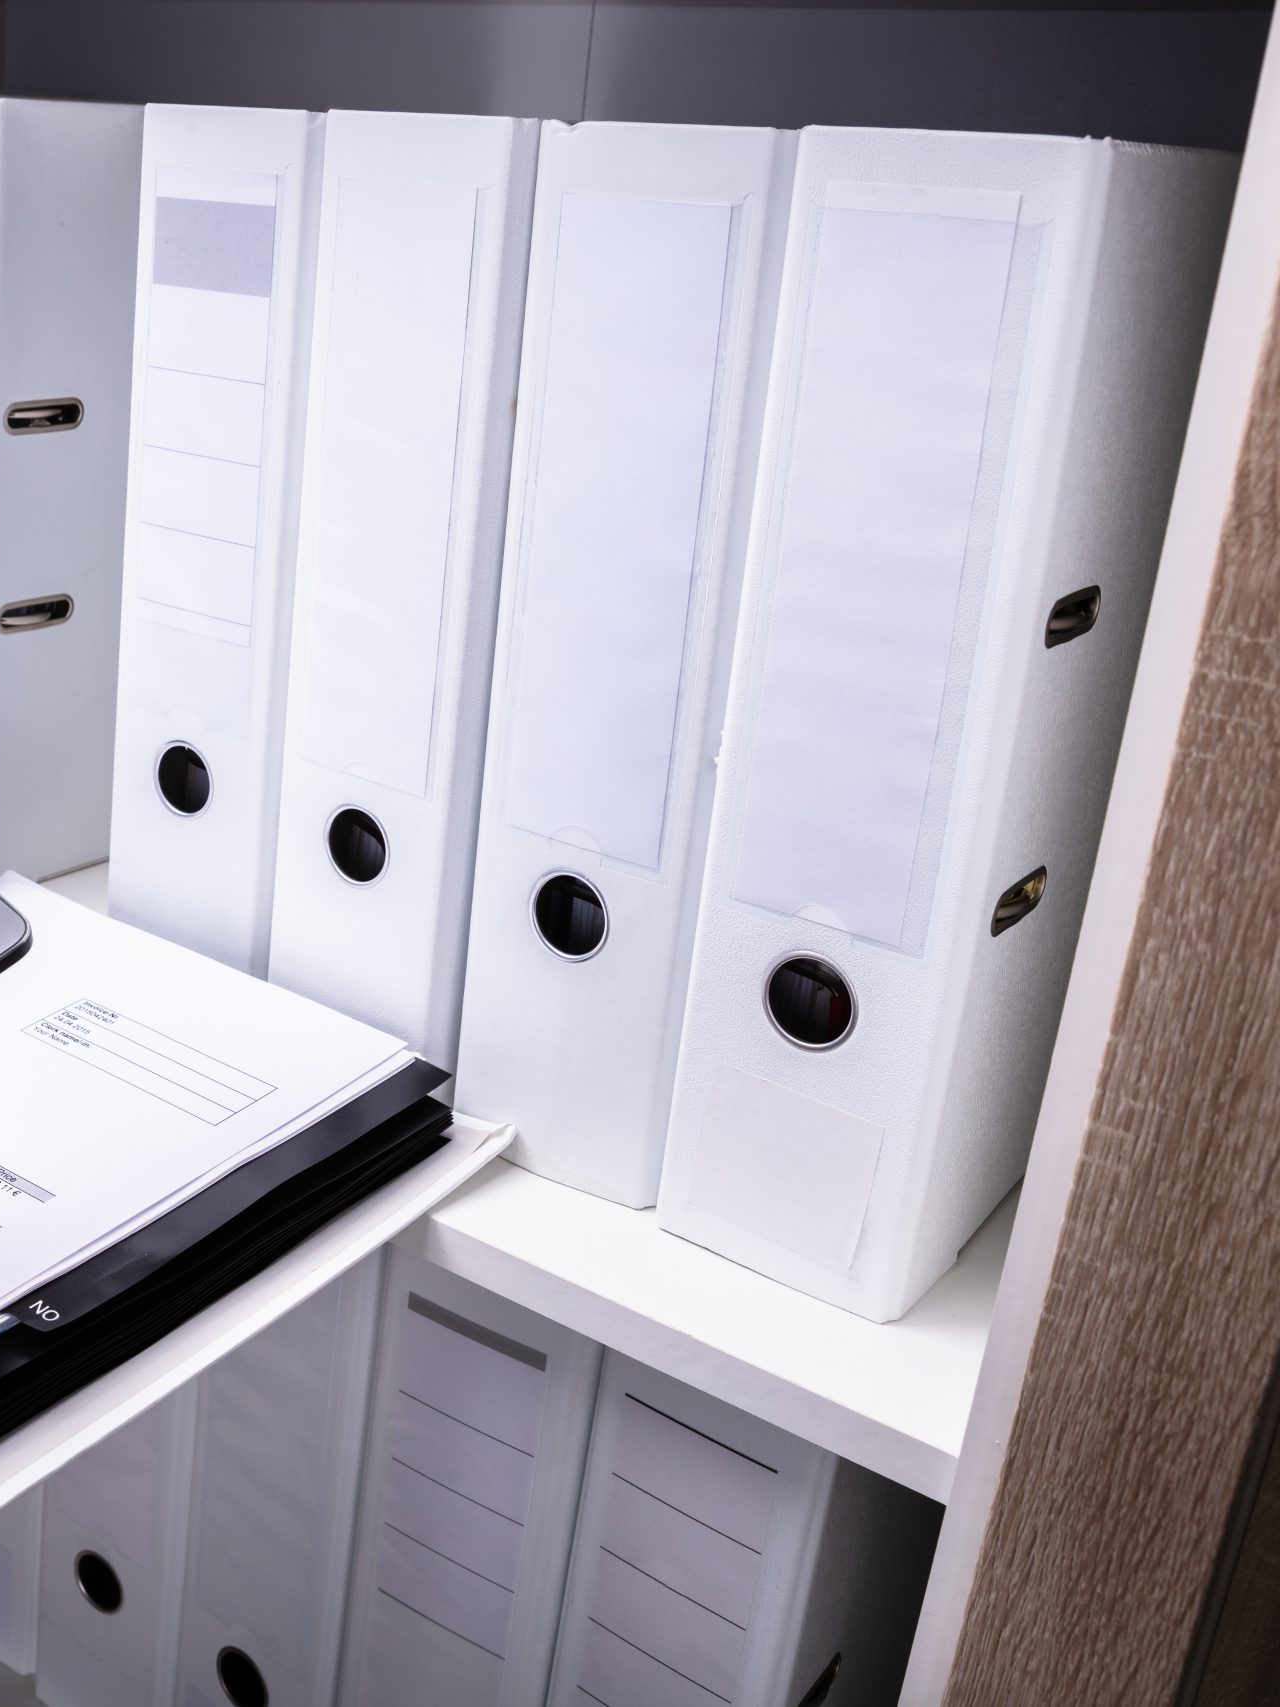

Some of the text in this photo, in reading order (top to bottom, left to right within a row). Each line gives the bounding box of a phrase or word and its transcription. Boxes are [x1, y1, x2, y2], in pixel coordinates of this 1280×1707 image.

[61, 1011, 78, 1021] Date
[41, 1022, 59, 1033] Clerk
[33, 1026, 70, 1045] Your Name
[28, 1299, 60, 1322] NO
